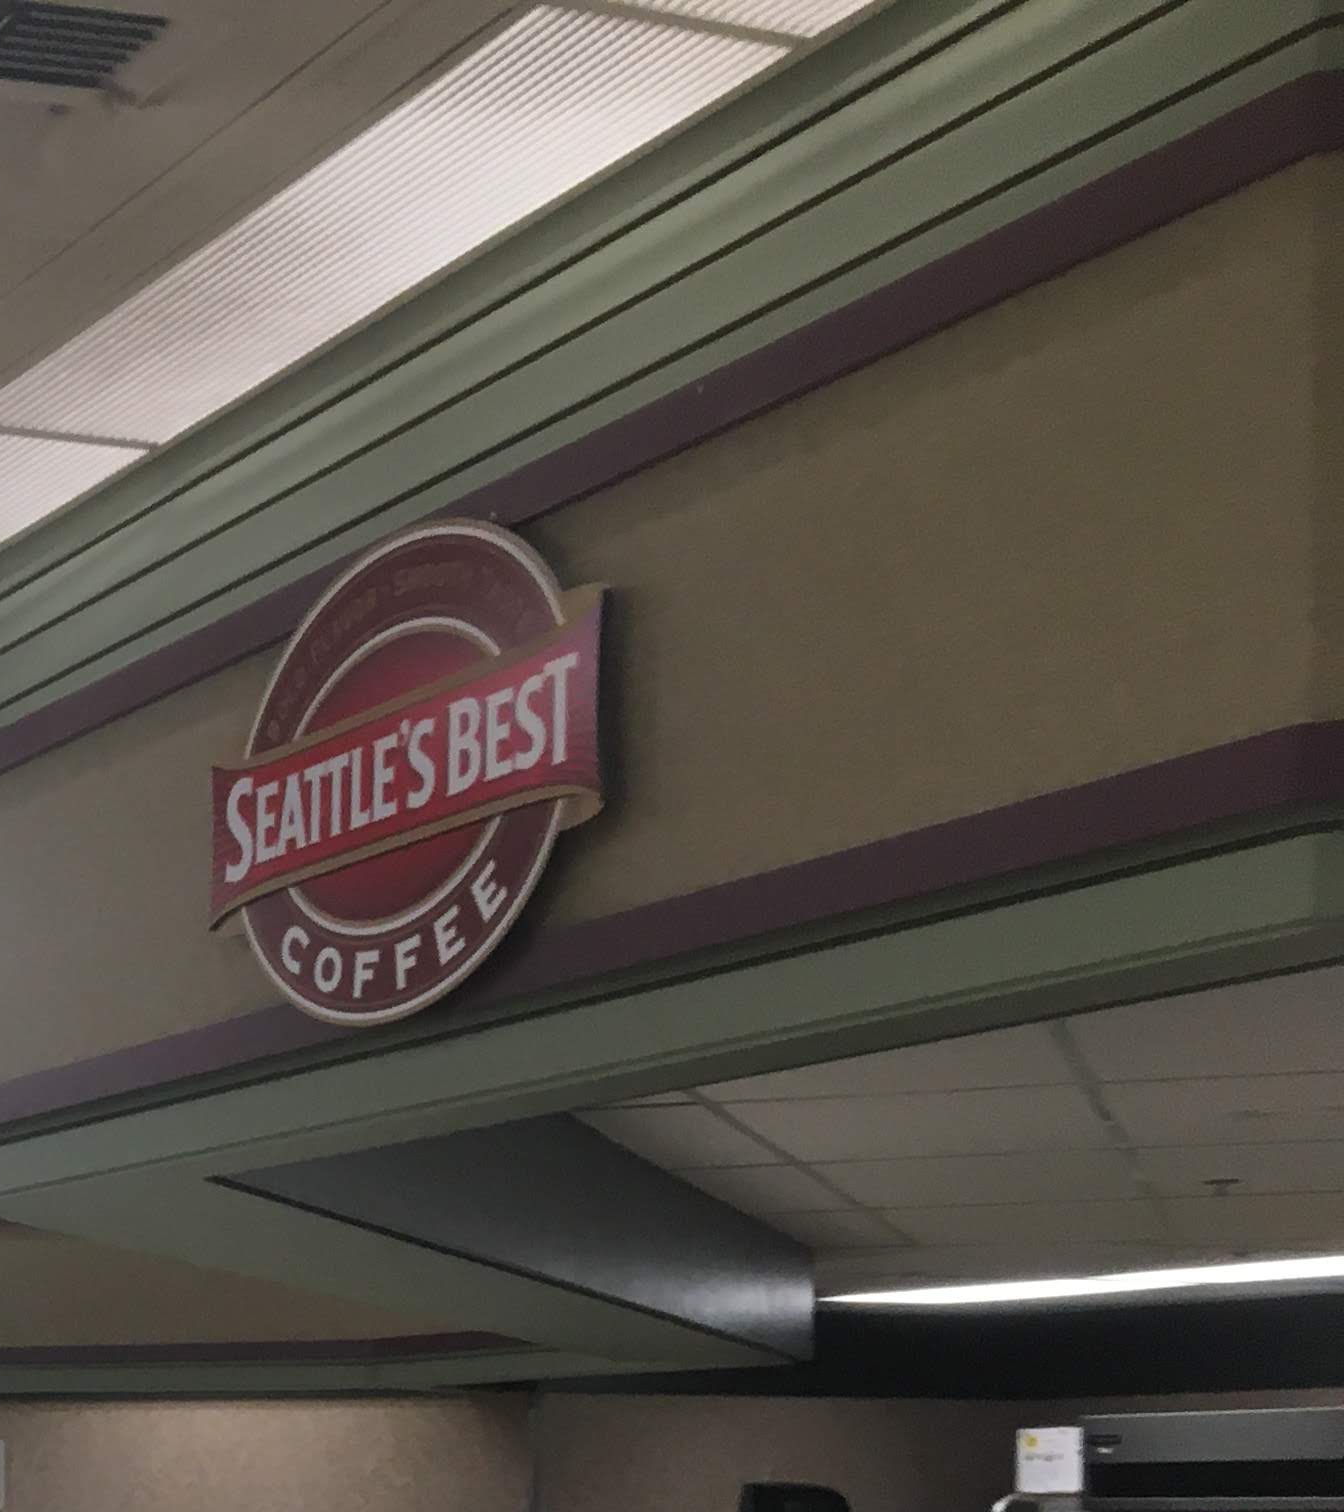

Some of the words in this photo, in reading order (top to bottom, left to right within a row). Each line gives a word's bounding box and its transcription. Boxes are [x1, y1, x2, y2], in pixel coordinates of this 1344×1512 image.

[223, 716, 436, 884] SEATTLE'S
[447, 650, 580, 799] BEST
[280, 860, 510, 1001] COFFEE
